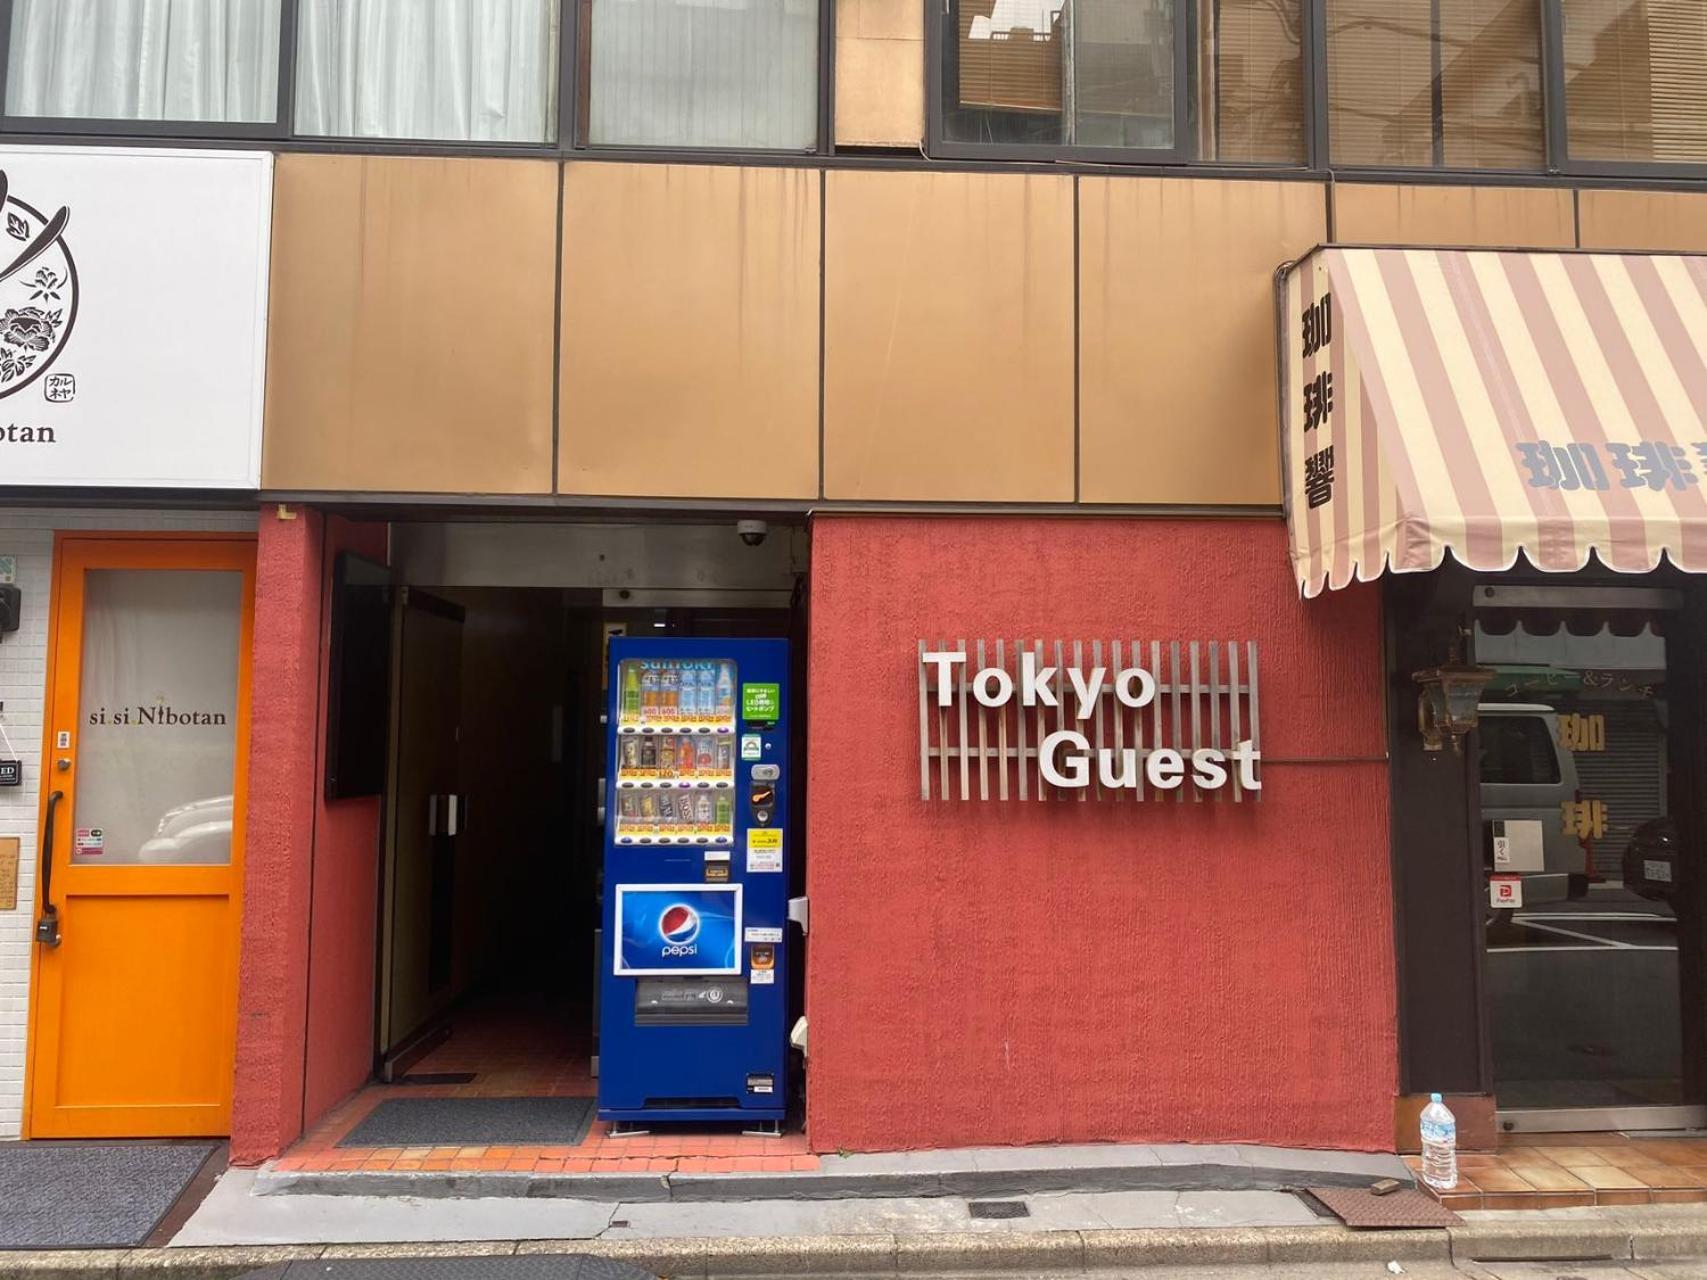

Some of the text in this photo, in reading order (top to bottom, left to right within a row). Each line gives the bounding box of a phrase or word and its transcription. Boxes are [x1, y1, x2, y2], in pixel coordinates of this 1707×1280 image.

[1516, 440, 1707, 491] 珈琲
[922, 651, 1156, 720] Tokyo
[1039, 729, 1262, 790] Guest
[661, 943, 698, 958] pepsi
